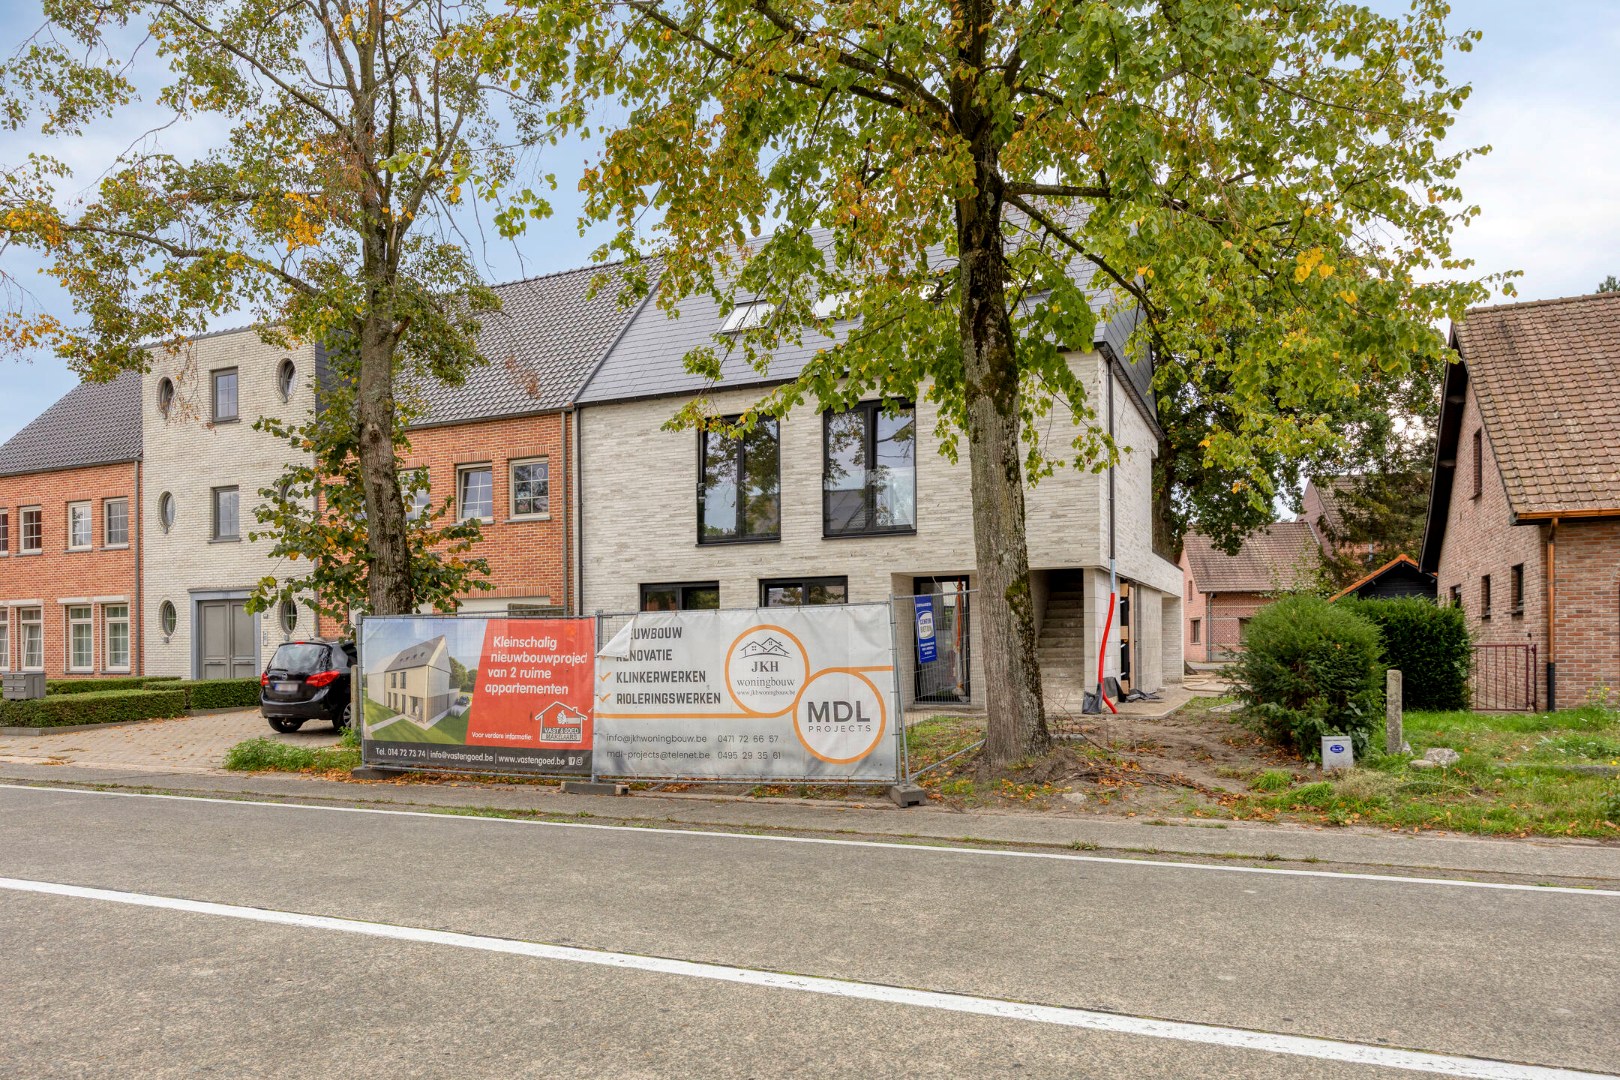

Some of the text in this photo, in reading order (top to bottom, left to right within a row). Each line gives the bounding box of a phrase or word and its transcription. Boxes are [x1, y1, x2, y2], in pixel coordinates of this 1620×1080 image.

[493, 636, 558, 651] Kleinschalig
[487, 666, 552, 679] van 2 ruime
[751, 660, 780, 673] JKH
[616, 670, 706, 683] KLINKERWERKEN
[736, 676, 796, 689] woningbouw
[485, 682, 569, 696] appartementen
[616, 692, 721, 705] RIOLERINGSWERKEN
[807, 700, 871, 723] MDL
[808, 724, 872, 733] PROJECTS
[606, 733, 779, 745] info@jkhwoningbouw.be 0471 72 66 57
[376, 747, 565, 766] Tel. 014 72 73 74 info@vastengoed.be www.vastengoed.be
[606, 750, 782, 761] mdl-projects@telenet.be 0495 29 35 61
